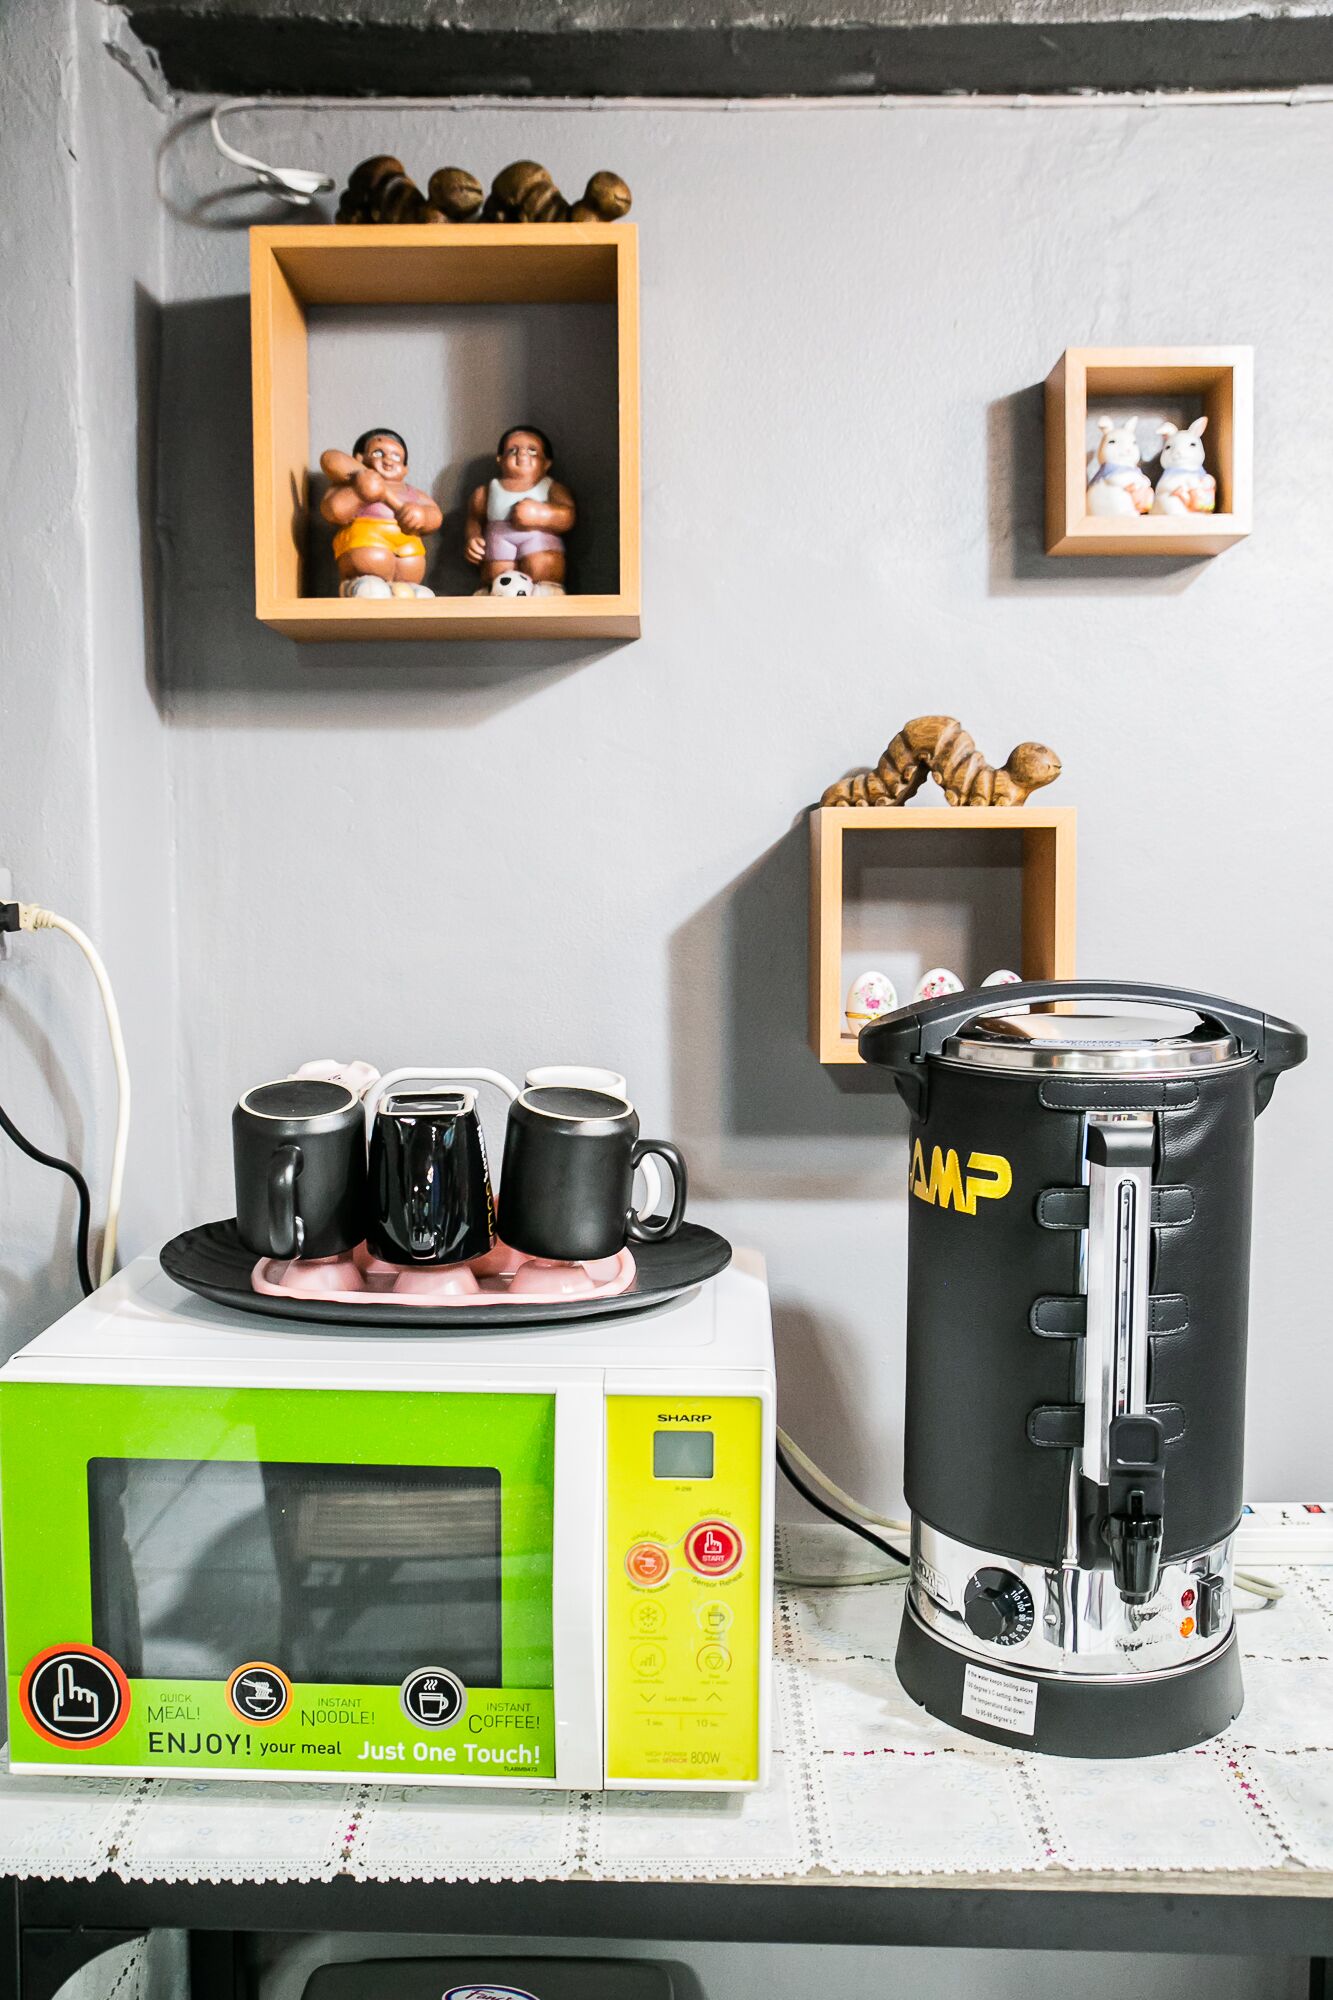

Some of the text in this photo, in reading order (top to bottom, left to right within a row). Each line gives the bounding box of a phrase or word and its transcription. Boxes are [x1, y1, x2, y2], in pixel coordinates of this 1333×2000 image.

[657, 1414, 712, 1422] SHARP
[160, 1693, 193, 1703] QUICK
[317, 1698, 362, 1708] INSTANT
[486, 1703, 532, 1712] INSTANT
[147, 1705, 200, 1724] MEAL!
[301, 1710, 376, 1727] NOODLE!
[468, 1714, 541, 1734] COFFEE!
[148, 1731, 541, 1765] ENJOY! your meal Just One Touch!
[690, 1751, 721, 1764] 800W
